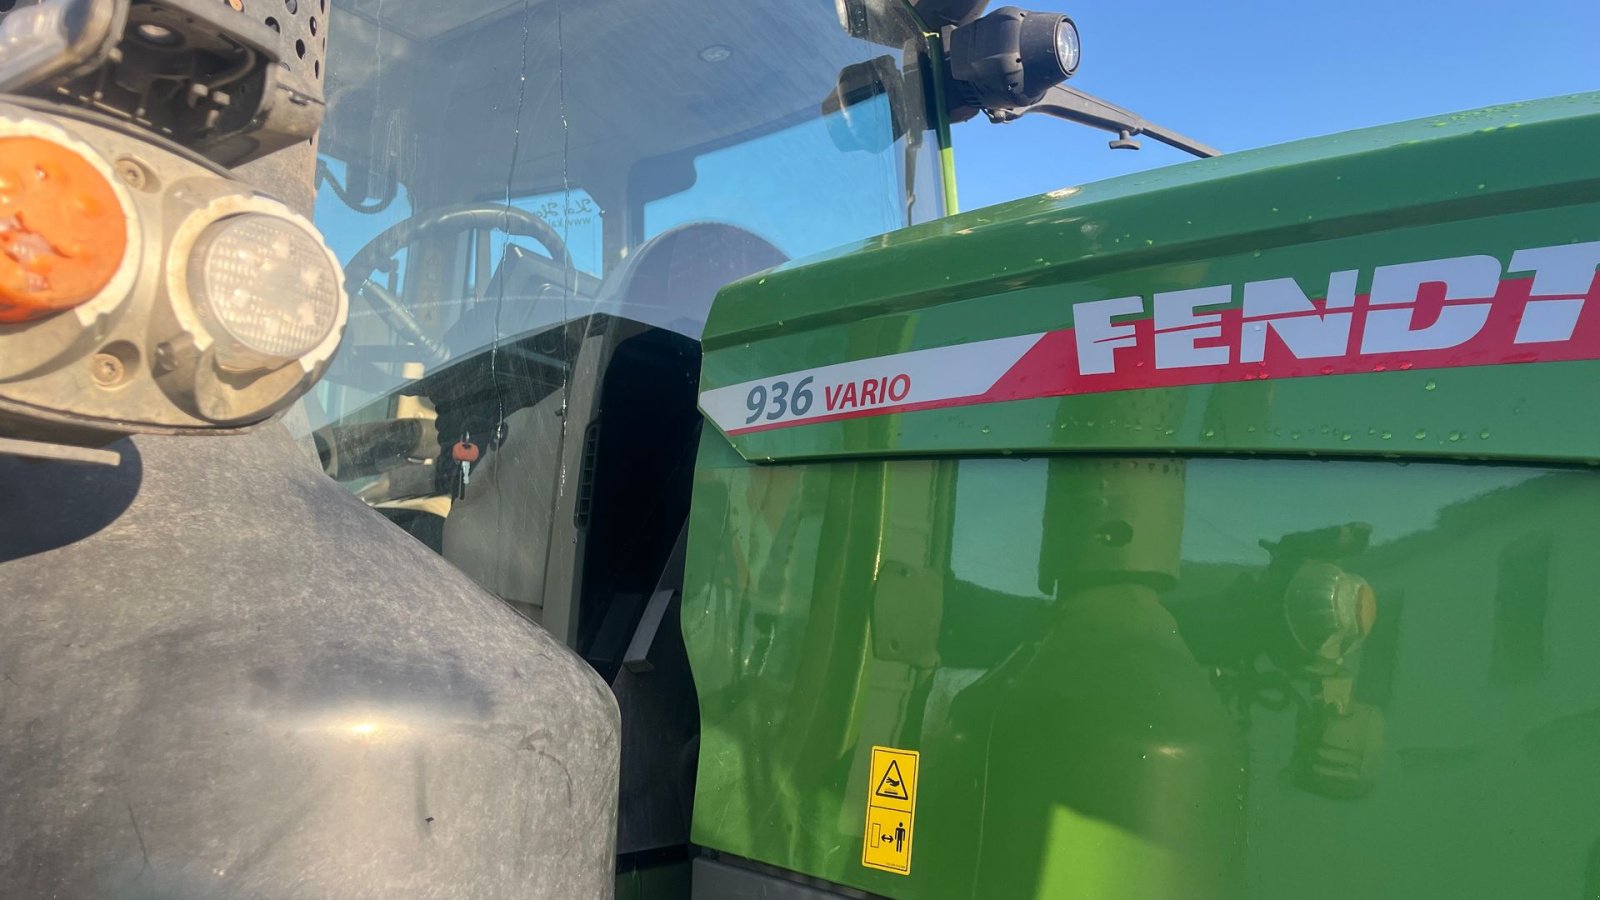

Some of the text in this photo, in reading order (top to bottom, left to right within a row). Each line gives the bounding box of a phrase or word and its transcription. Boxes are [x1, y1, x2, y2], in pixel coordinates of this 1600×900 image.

[1073, 241, 1600, 376] FENDT
[745, 373, 911, 425] 936 VARIO
